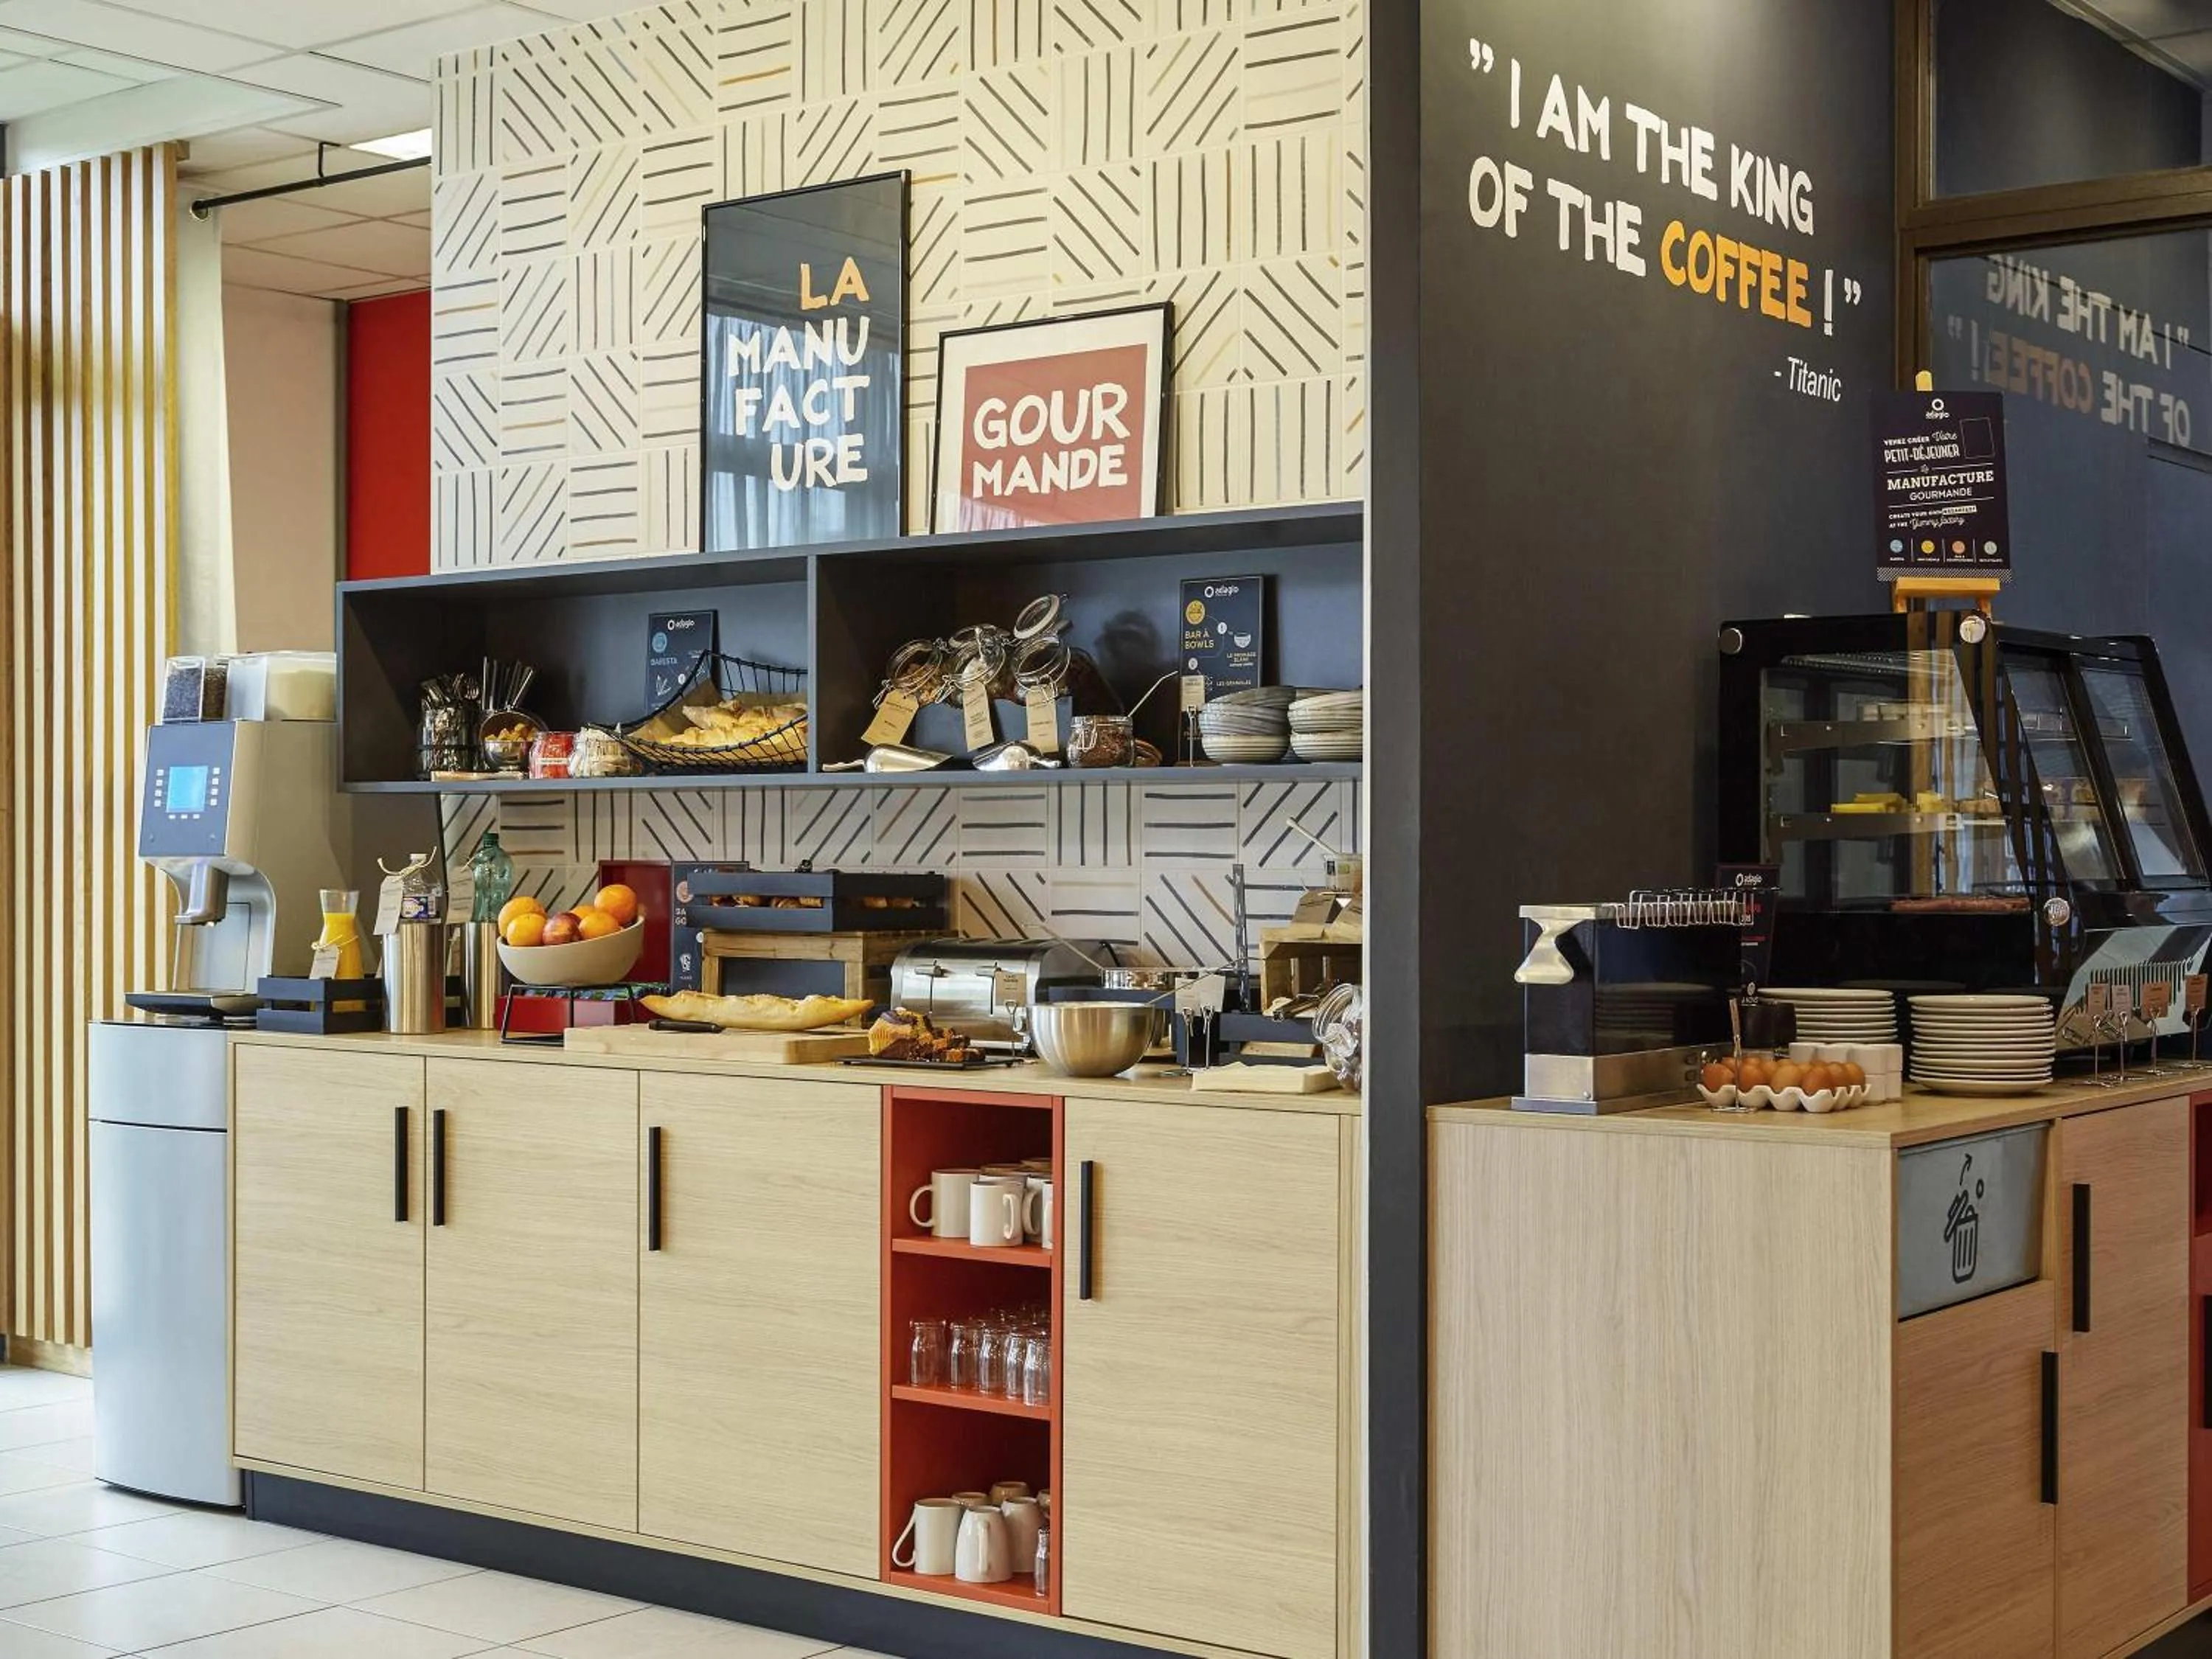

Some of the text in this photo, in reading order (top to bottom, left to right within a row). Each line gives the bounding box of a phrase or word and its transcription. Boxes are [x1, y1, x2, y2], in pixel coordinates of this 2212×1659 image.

[1537, 74, 1610, 161] AM
[1626, 102, 1717, 201] THE
[1731, 143, 1814, 235] KING
[1469, 156, 1534, 238] OF
[1547, 177, 1646, 277] THE
[1661, 220, 1812, 328] COFFEE
[801, 257, 869, 310] LA
[728, 316, 870, 377] MANU
[736, 375, 870, 435] FACT
[1788, 356, 1842, 403] Titanic
[973, 383, 1131, 450] GOUR
[771, 433, 868, 492] URE
[973, 444, 1128, 498] MANDE
[1887, 470, 1994, 490] MANUFACTURE
[1909, 487, 1973, 501] GOURMANDE
[1185, 630, 1201, 639] BAR
[1185, 639, 1214, 650] BOWLS
